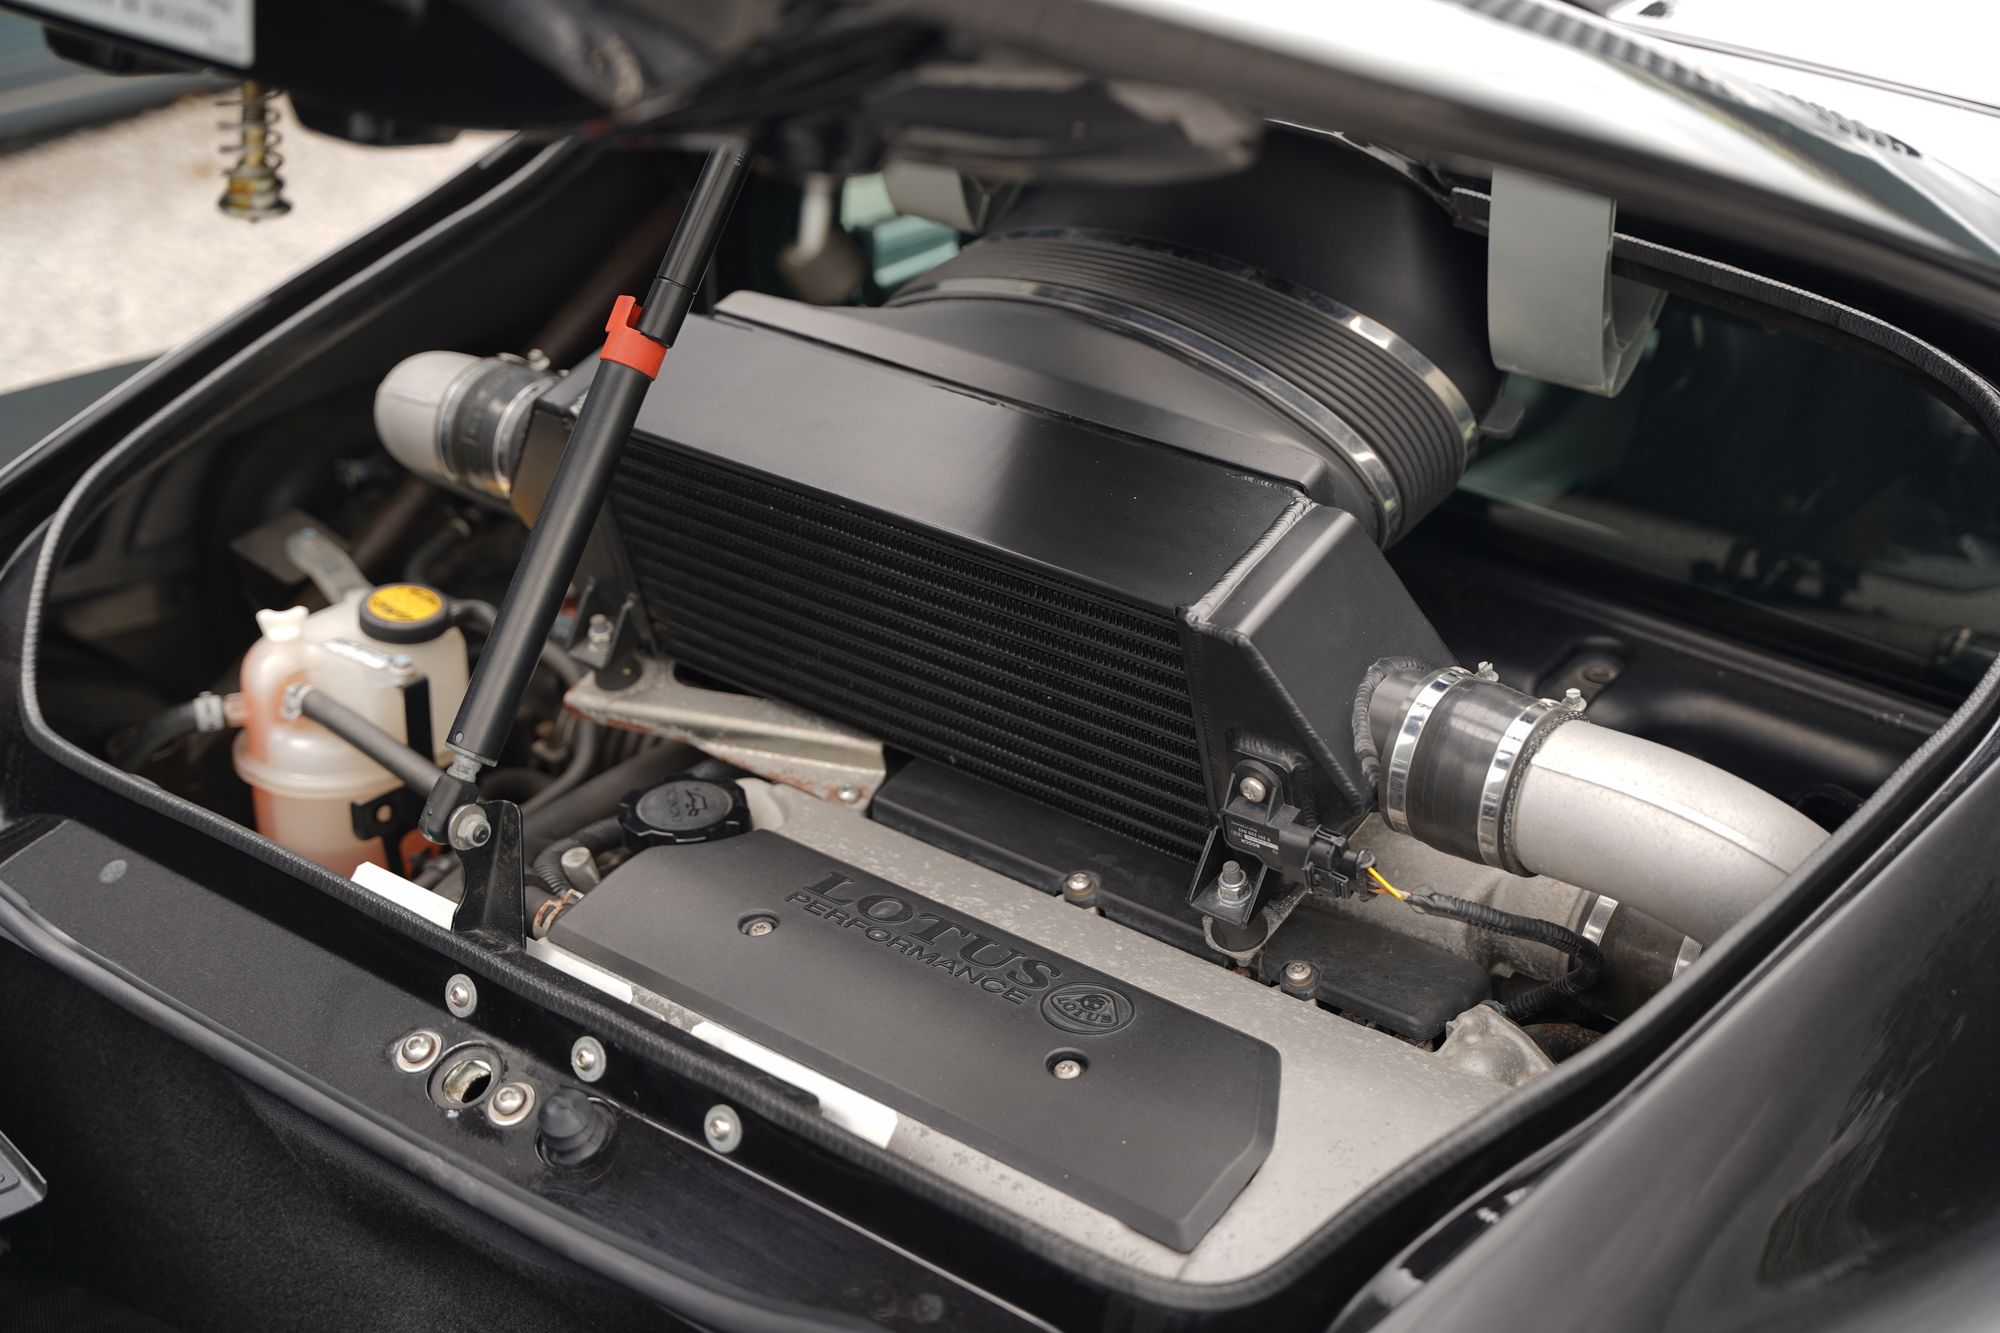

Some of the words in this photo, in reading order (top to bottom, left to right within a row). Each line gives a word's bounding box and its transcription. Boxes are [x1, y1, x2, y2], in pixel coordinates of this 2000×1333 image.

[785, 891, 1033, 1006] PERFORMANCE
[802, 871, 1063, 990] LOTUS
[1056, 996, 1113, 1024] LOTUS
